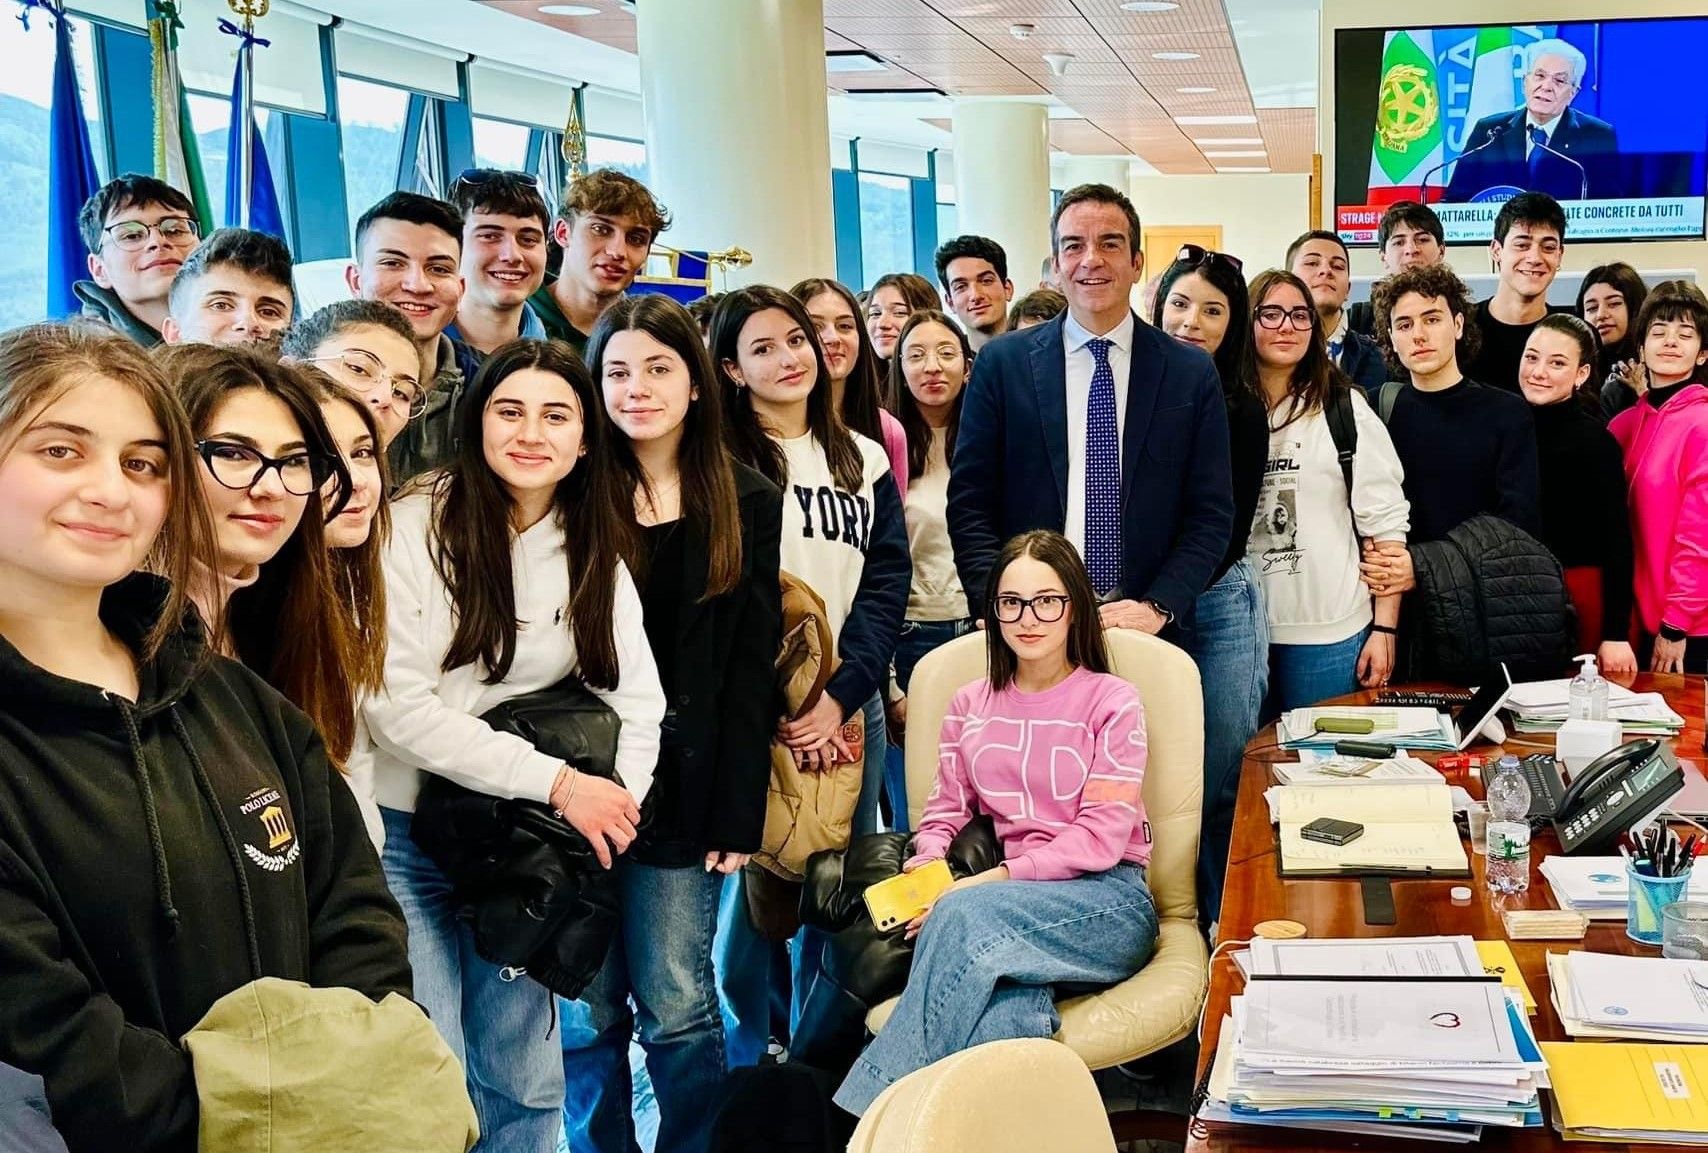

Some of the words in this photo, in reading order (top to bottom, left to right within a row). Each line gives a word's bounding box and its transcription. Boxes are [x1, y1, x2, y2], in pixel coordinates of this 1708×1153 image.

[1340, 212, 1376, 225] STRAGE
[1584, 205, 1636, 219] CONCRETE
[1638, 205, 1652, 218] DA
[1655, 204, 1683, 217] TUTTI
[240, 798, 261, 815] POLO
